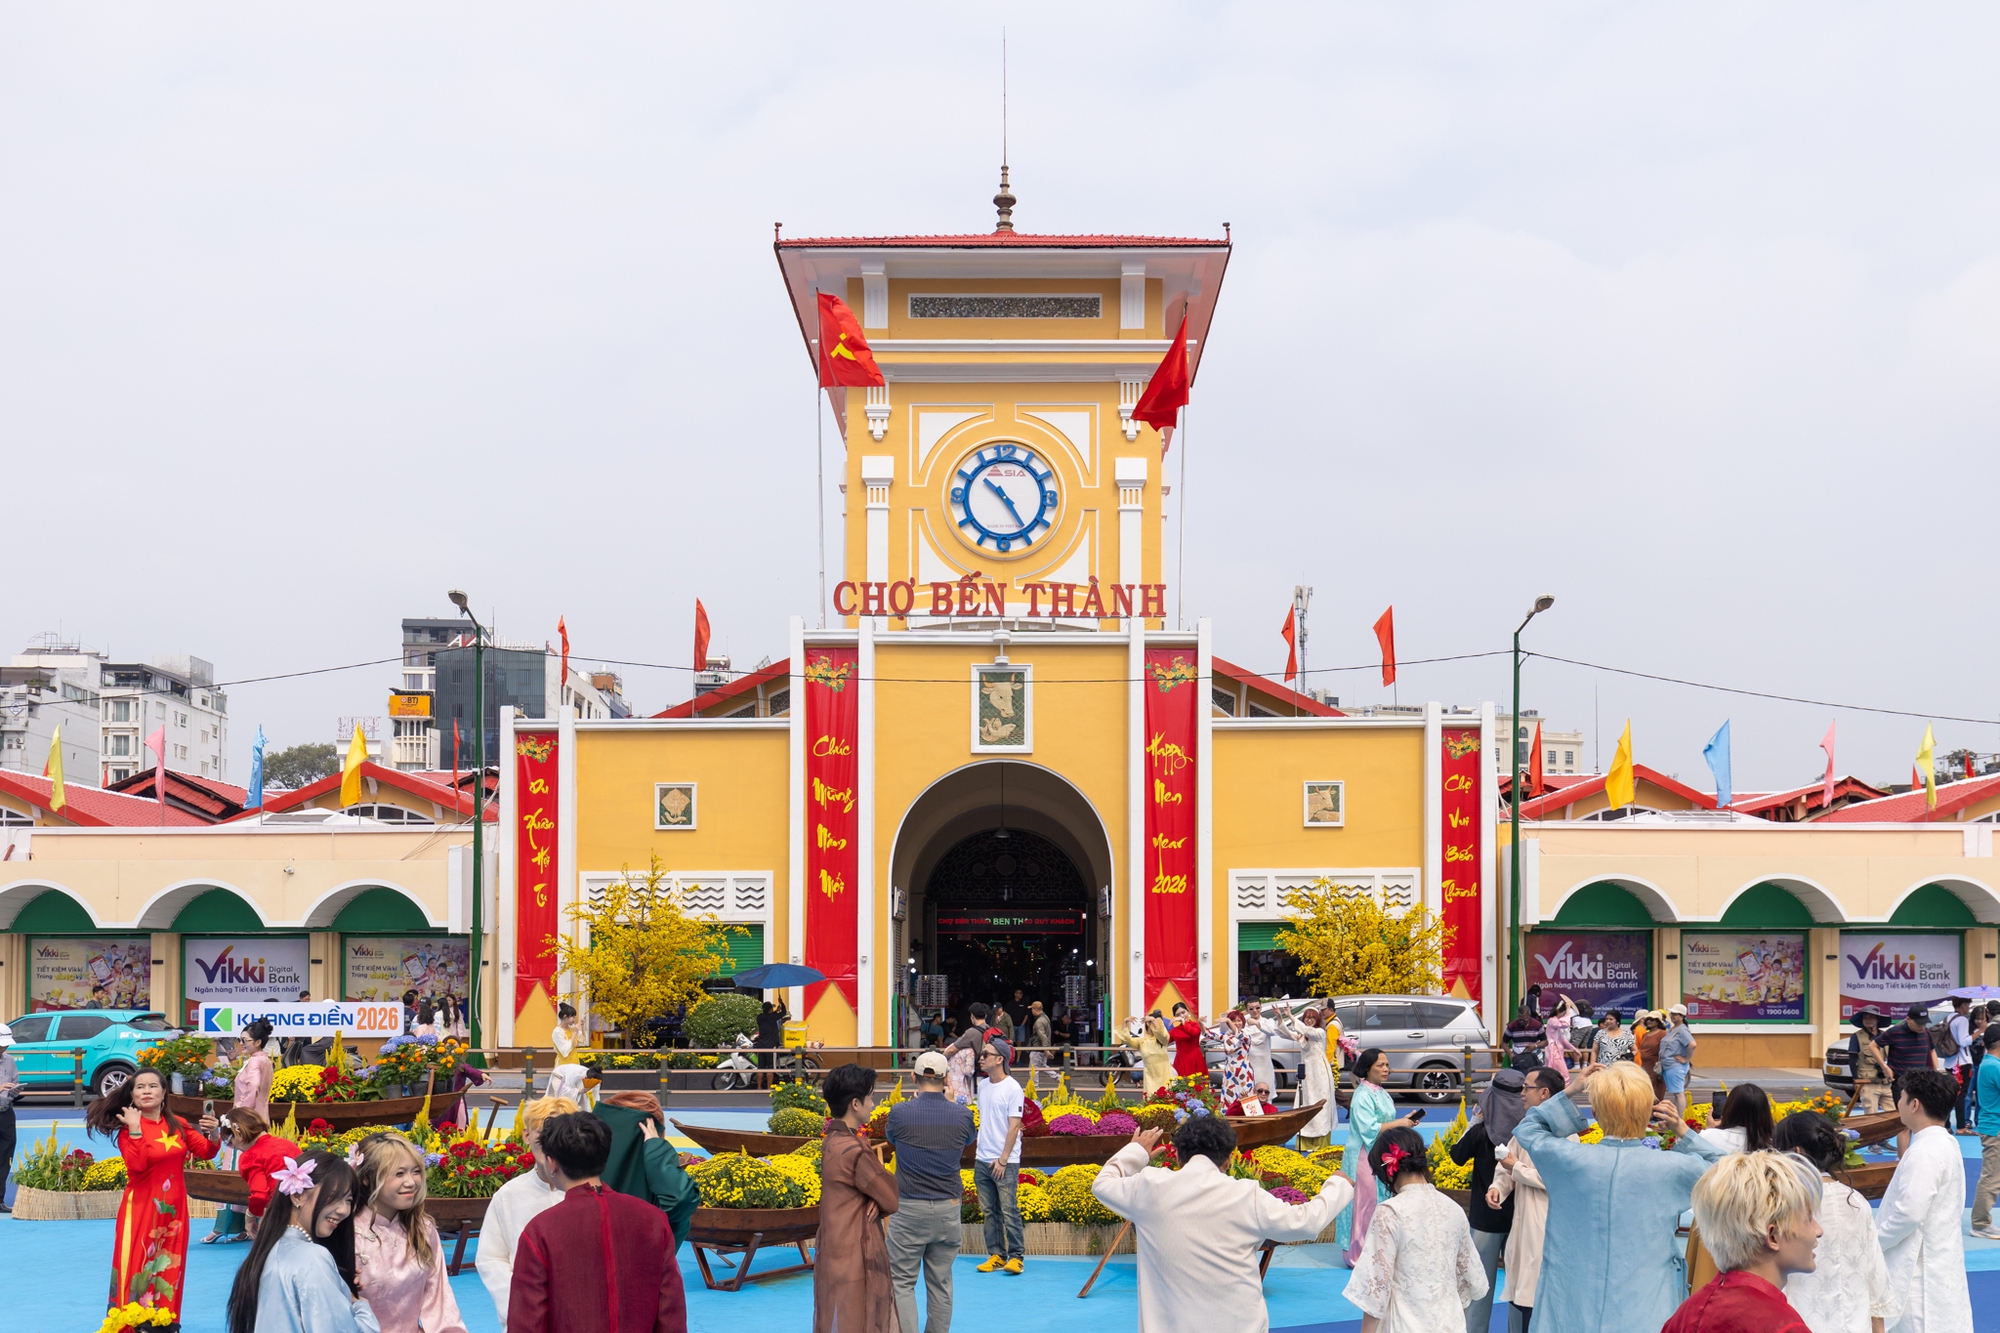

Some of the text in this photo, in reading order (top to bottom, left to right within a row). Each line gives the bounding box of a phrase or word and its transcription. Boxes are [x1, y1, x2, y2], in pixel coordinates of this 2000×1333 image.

[994, 444, 1017, 460] 12
[950, 487, 965, 504] 9
[1042, 490, 1058, 507] 3
[996, 534, 1011, 551] 6
[834, 570, 1166, 620] CHỢ BẾN THÀNH
[813, 735, 852, 756] Chúc
[1146, 730, 1194, 776] Happy
[1444, 774, 1473, 794] Chợ
[812, 777, 858, 814] Mừng
[1448, 806, 1470, 828] Vui
[1152, 832, 1188, 877] Year
[1444, 844, 1474, 862] Bến
[1152, 874, 1187, 894] 2026
[195, 945, 265, 984] Vikki
[1534, 941, 1603, 979] Vikki
[1607, 962, 1631, 970] Digital
[1847, 942, 1916, 980] Vikki
[268, 973, 300, 984] Bank
[1607, 969, 1638, 980] Bank
[1919, 970, 1950, 980] Bank
[195, 984, 300, 994] Ngân hàng Tiết kiệm Tốt nhất!
[1589, 982, 1605, 990] kiệm
[1847, 981, 1950, 990] Ngân hàng Tiết kiệm Tốt nhất!
[238, 1006, 398, 1030] KHANG ĐIỀN 2026
